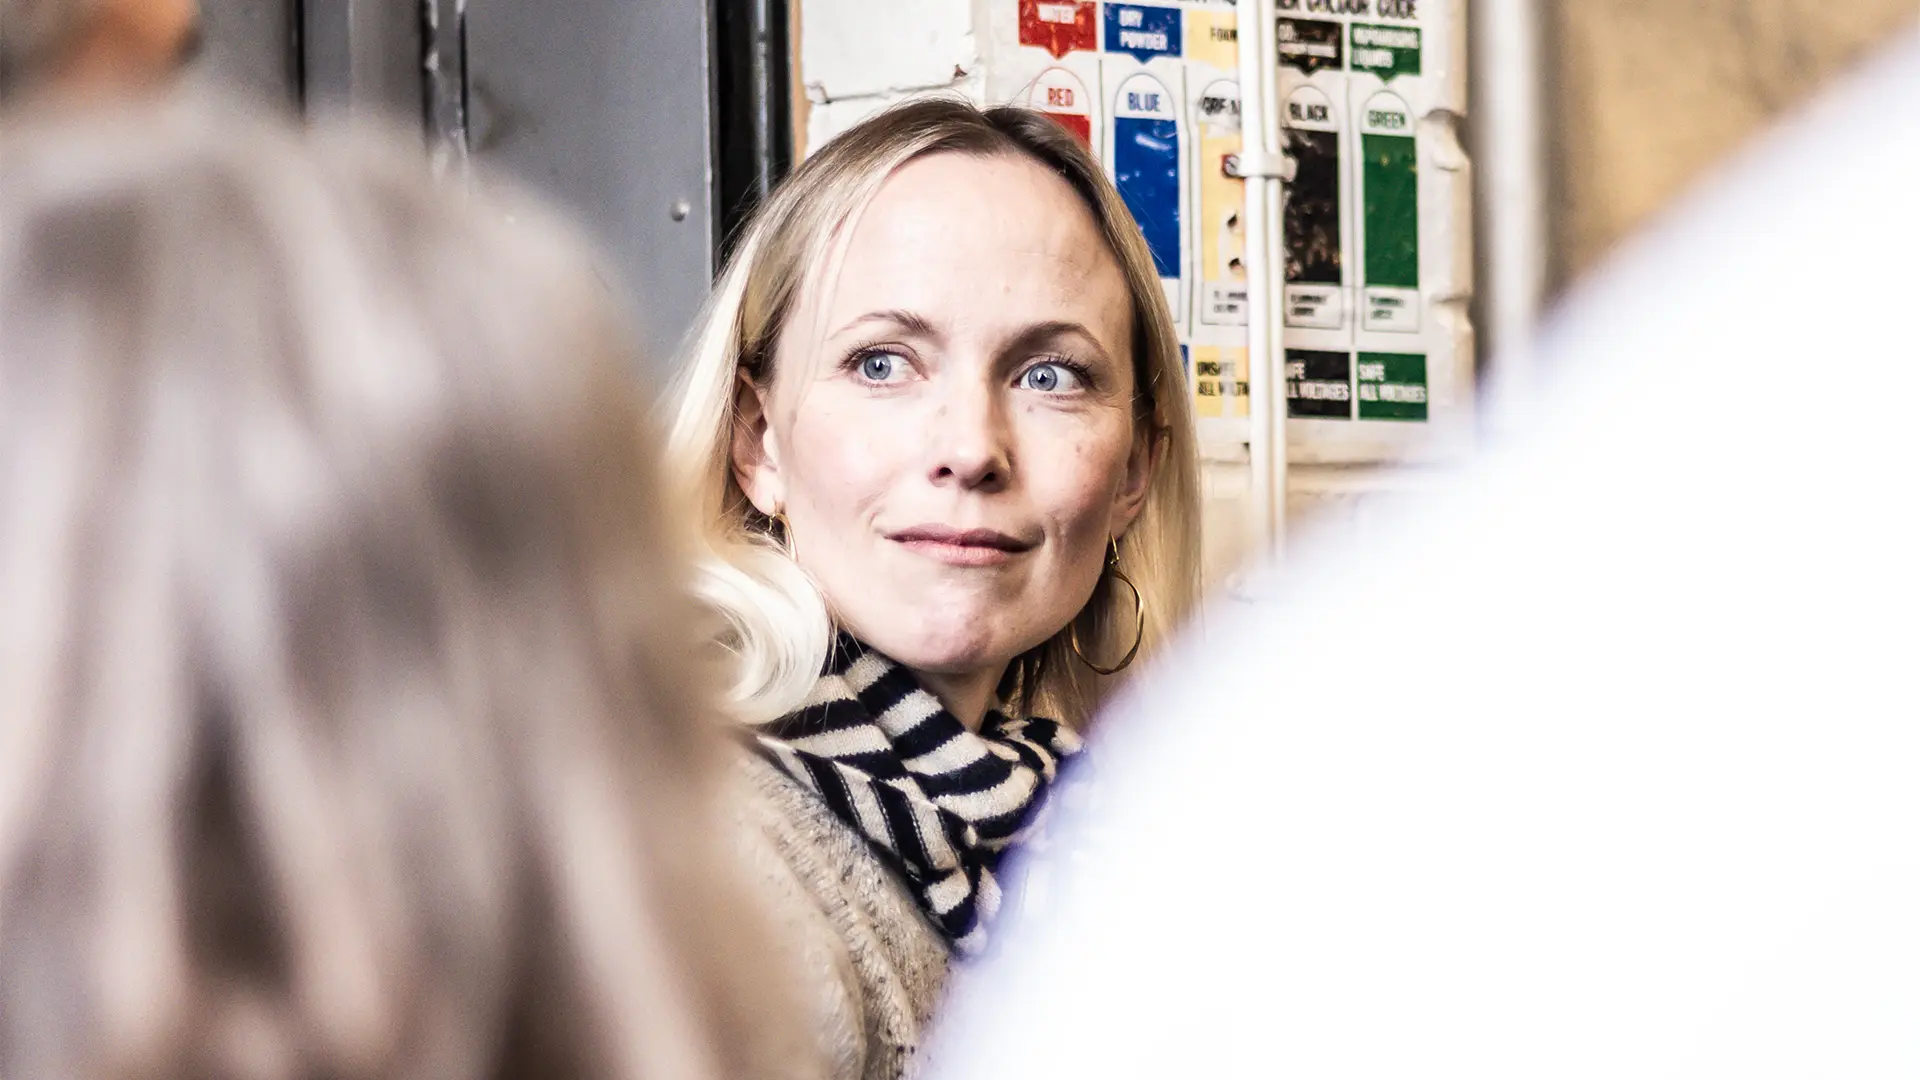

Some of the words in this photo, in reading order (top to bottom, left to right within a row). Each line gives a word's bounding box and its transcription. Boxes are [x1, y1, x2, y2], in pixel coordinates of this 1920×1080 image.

[1118, 9, 1143, 28] DRY
[1119, 30, 1168, 51] POWDER
[1047, 87, 1074, 107] RED
[1128, 92, 1162, 112] BLUE
[1289, 102, 1328, 122] BLACK
[1368, 109, 1406, 129] GREEN
[1360, 362, 1385, 382] SAFE
